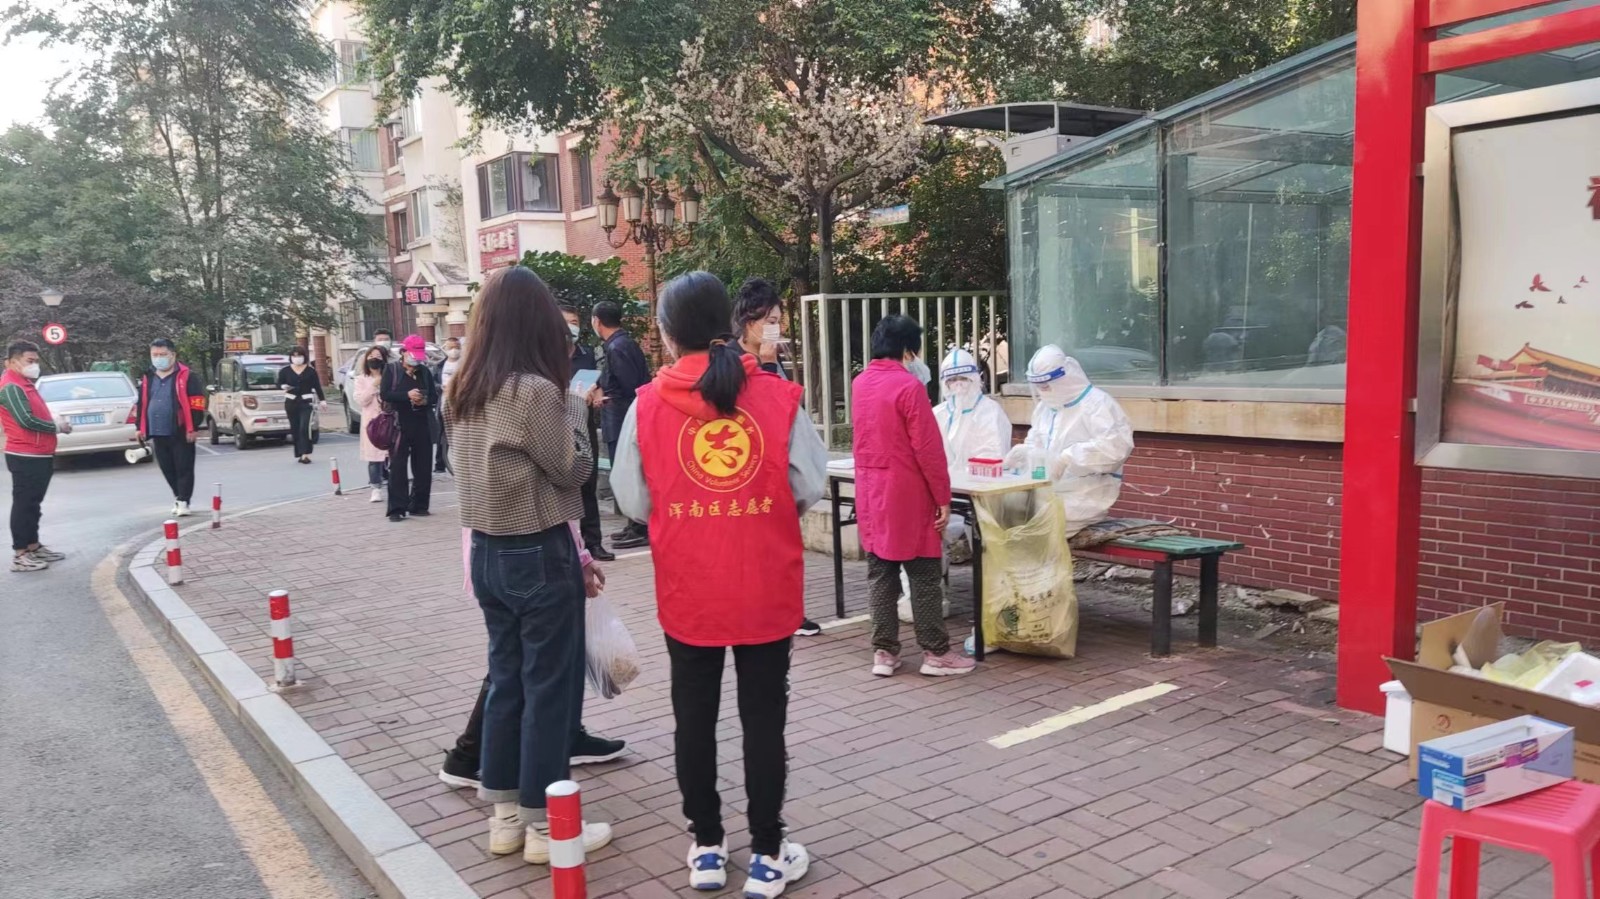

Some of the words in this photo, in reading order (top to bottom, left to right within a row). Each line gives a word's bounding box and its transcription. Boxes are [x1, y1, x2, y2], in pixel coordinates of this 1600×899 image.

[405, 287, 432, 303] 超市
[51, 328, 60, 340] 5
[686, 460, 704, 480] China
[668, 496, 773, 519] 浑南区志愿者
